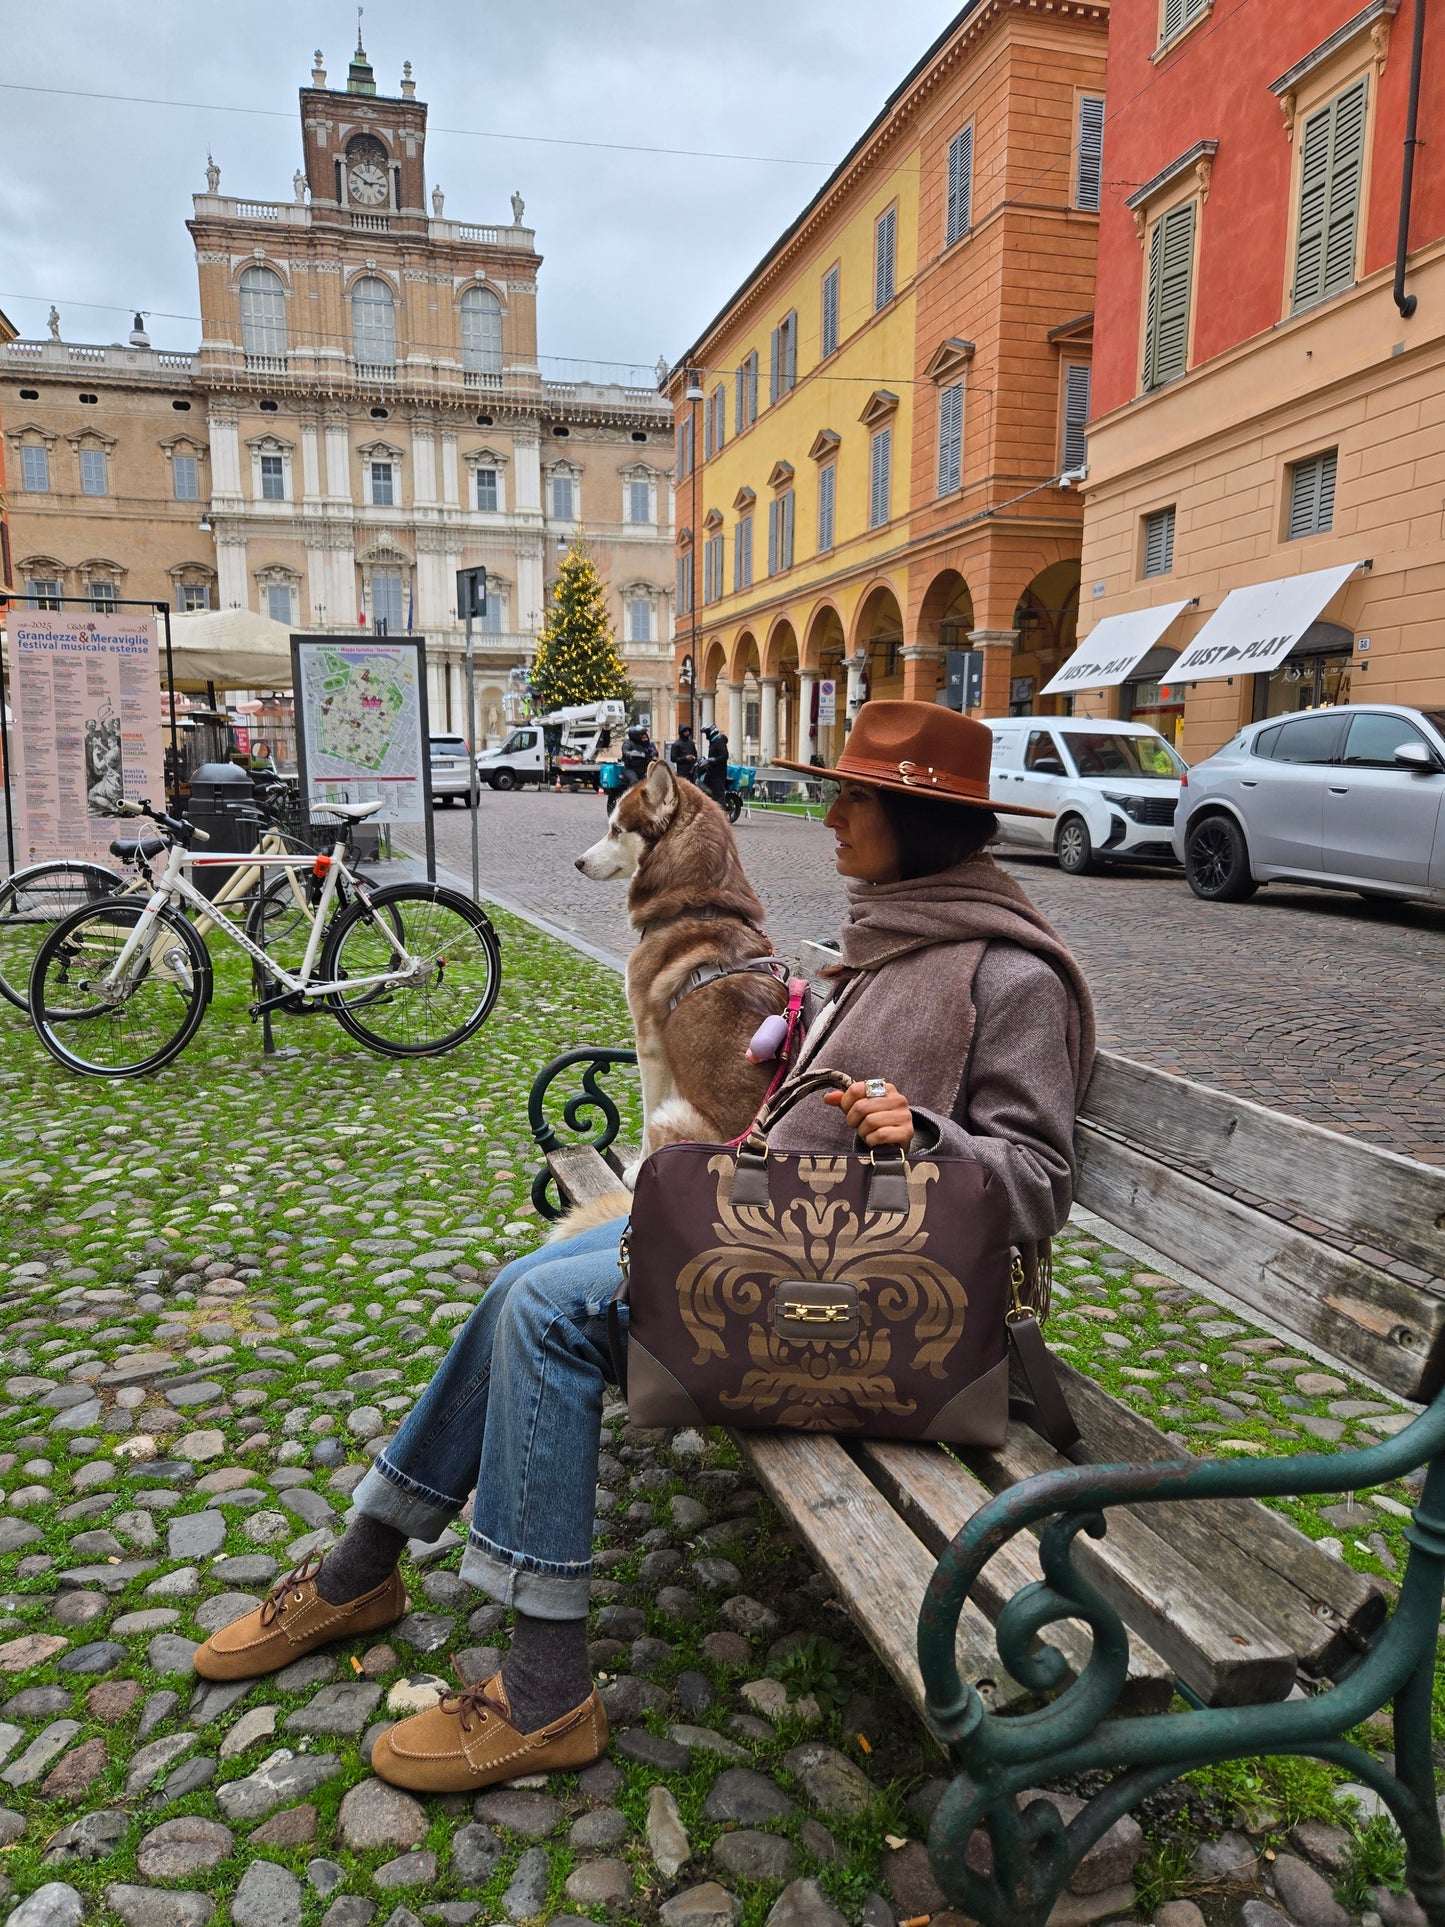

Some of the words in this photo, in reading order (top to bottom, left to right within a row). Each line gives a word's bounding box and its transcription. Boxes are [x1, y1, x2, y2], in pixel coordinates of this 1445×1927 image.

[17, 630, 77, 641] Grandezze
[78, 631, 89, 643] &
[90, 632, 149, 646] Meraviglie
[18, 640, 58, 649] festival
[61, 641, 107, 652] musicale
[109, 645, 149, 654] estense
[1180, 645, 1230, 668] JUST
[1237, 634, 1294, 661] PLAY
[1058, 664, 1095, 681] JUST
[1098, 655, 1138, 676] PLAY
[198, 896, 276, 970] CENTURION
